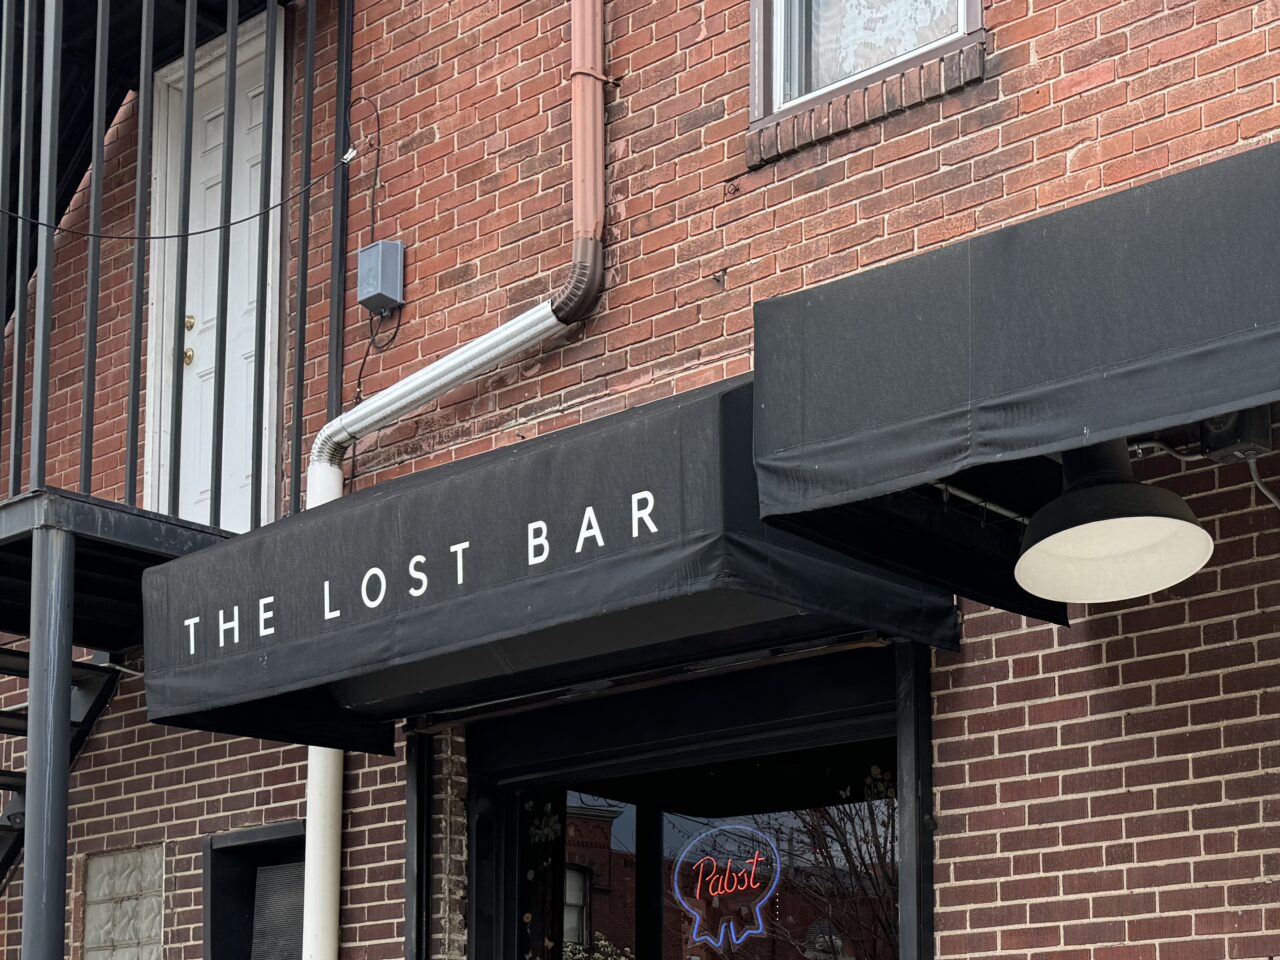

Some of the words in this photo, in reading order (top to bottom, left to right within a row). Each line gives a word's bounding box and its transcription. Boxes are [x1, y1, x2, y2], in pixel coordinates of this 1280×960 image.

[184, 596, 275, 655] THE
[323, 541, 470, 620] LOST
[528, 490, 659, 565] BAR
[692, 850, 765, 900] Pabst
